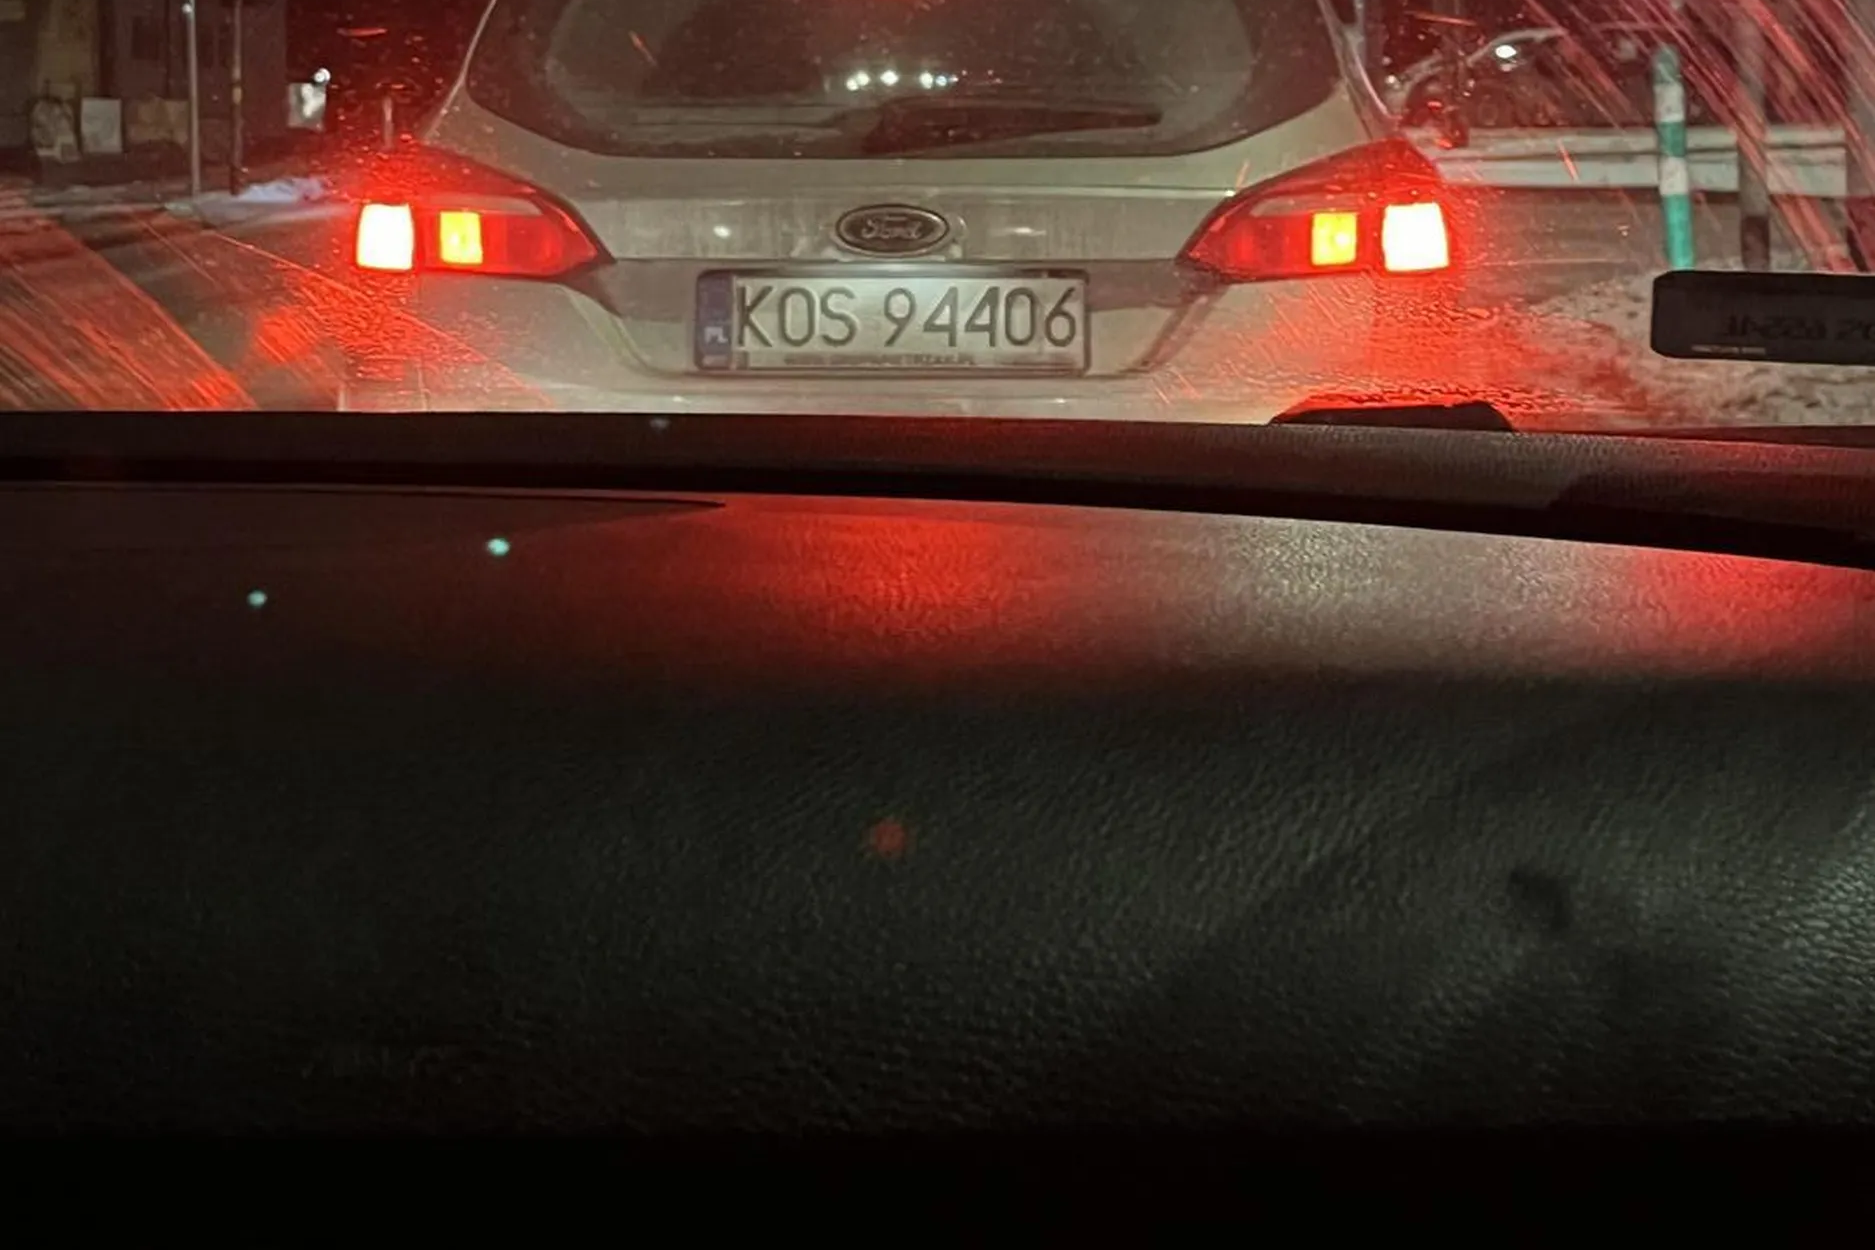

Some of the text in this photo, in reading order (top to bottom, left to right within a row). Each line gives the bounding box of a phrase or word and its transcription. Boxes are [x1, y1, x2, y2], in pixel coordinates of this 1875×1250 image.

[860, 214, 922, 240] Ford
[737, 285, 1077, 348] KOS 94406
[704, 326, 729, 344] PL
